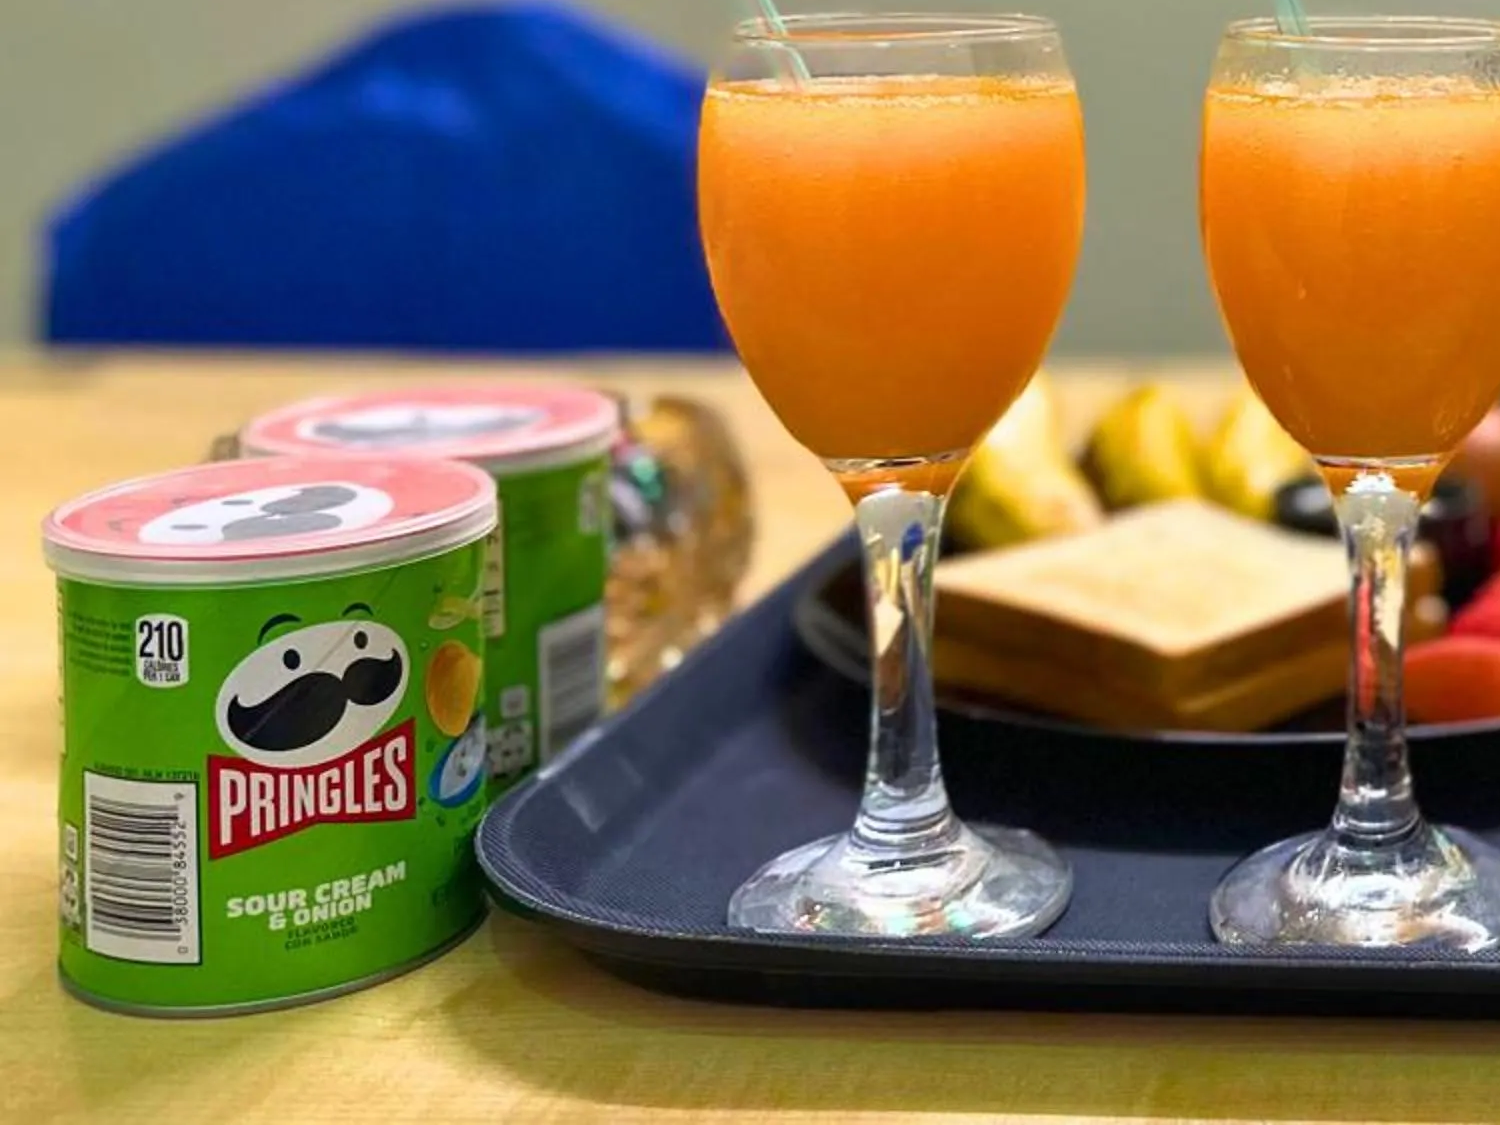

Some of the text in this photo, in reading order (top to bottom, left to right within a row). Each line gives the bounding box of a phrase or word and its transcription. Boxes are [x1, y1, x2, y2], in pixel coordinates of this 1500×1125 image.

[138, 620, 184, 662] 210
[219, 735, 408, 846] PRINGLES
[226, 861, 407, 918] SOUR CREAM
[268, 892, 373, 931] & ONION
